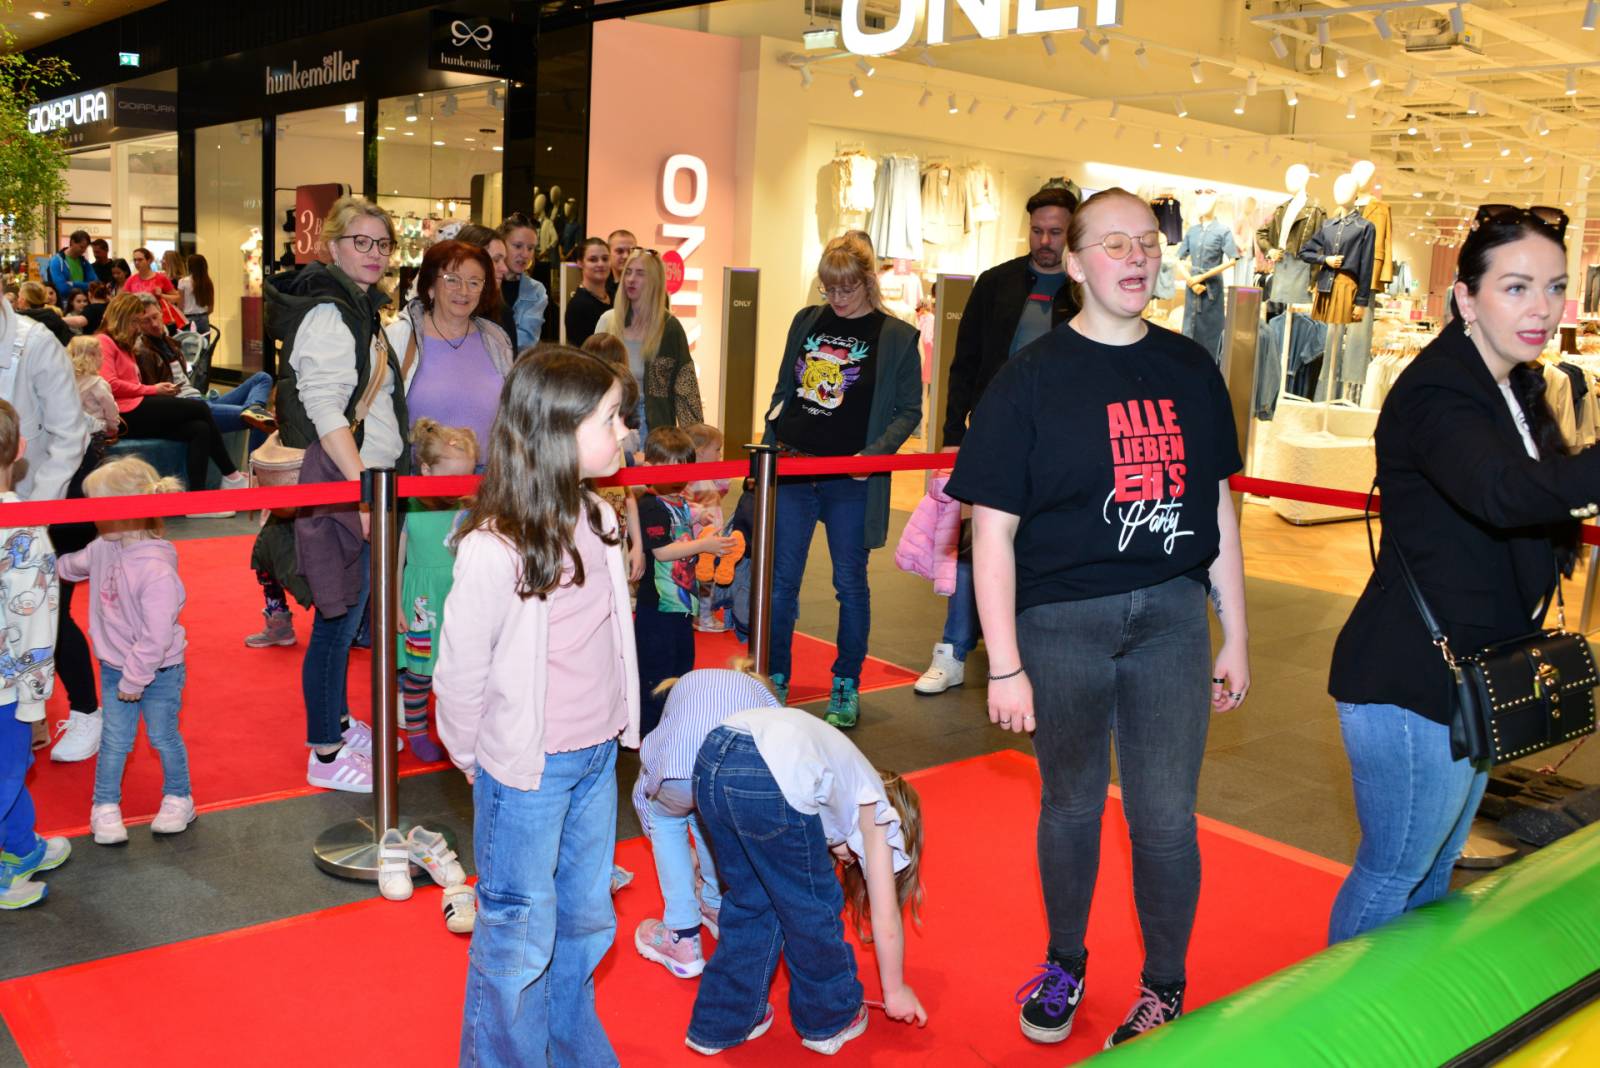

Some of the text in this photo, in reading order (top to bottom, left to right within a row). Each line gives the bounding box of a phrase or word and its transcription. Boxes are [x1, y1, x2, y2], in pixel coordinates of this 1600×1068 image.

[266, 51, 360, 95] hunkemöller
[441, 52, 501, 71] hunkemöller
[733, 299, 752, 307] ONLY
[1106, 399, 1182, 438] ALLE
[1111, 435, 1185, 464] LIEBEN
[1103, 487, 1195, 555] Party
